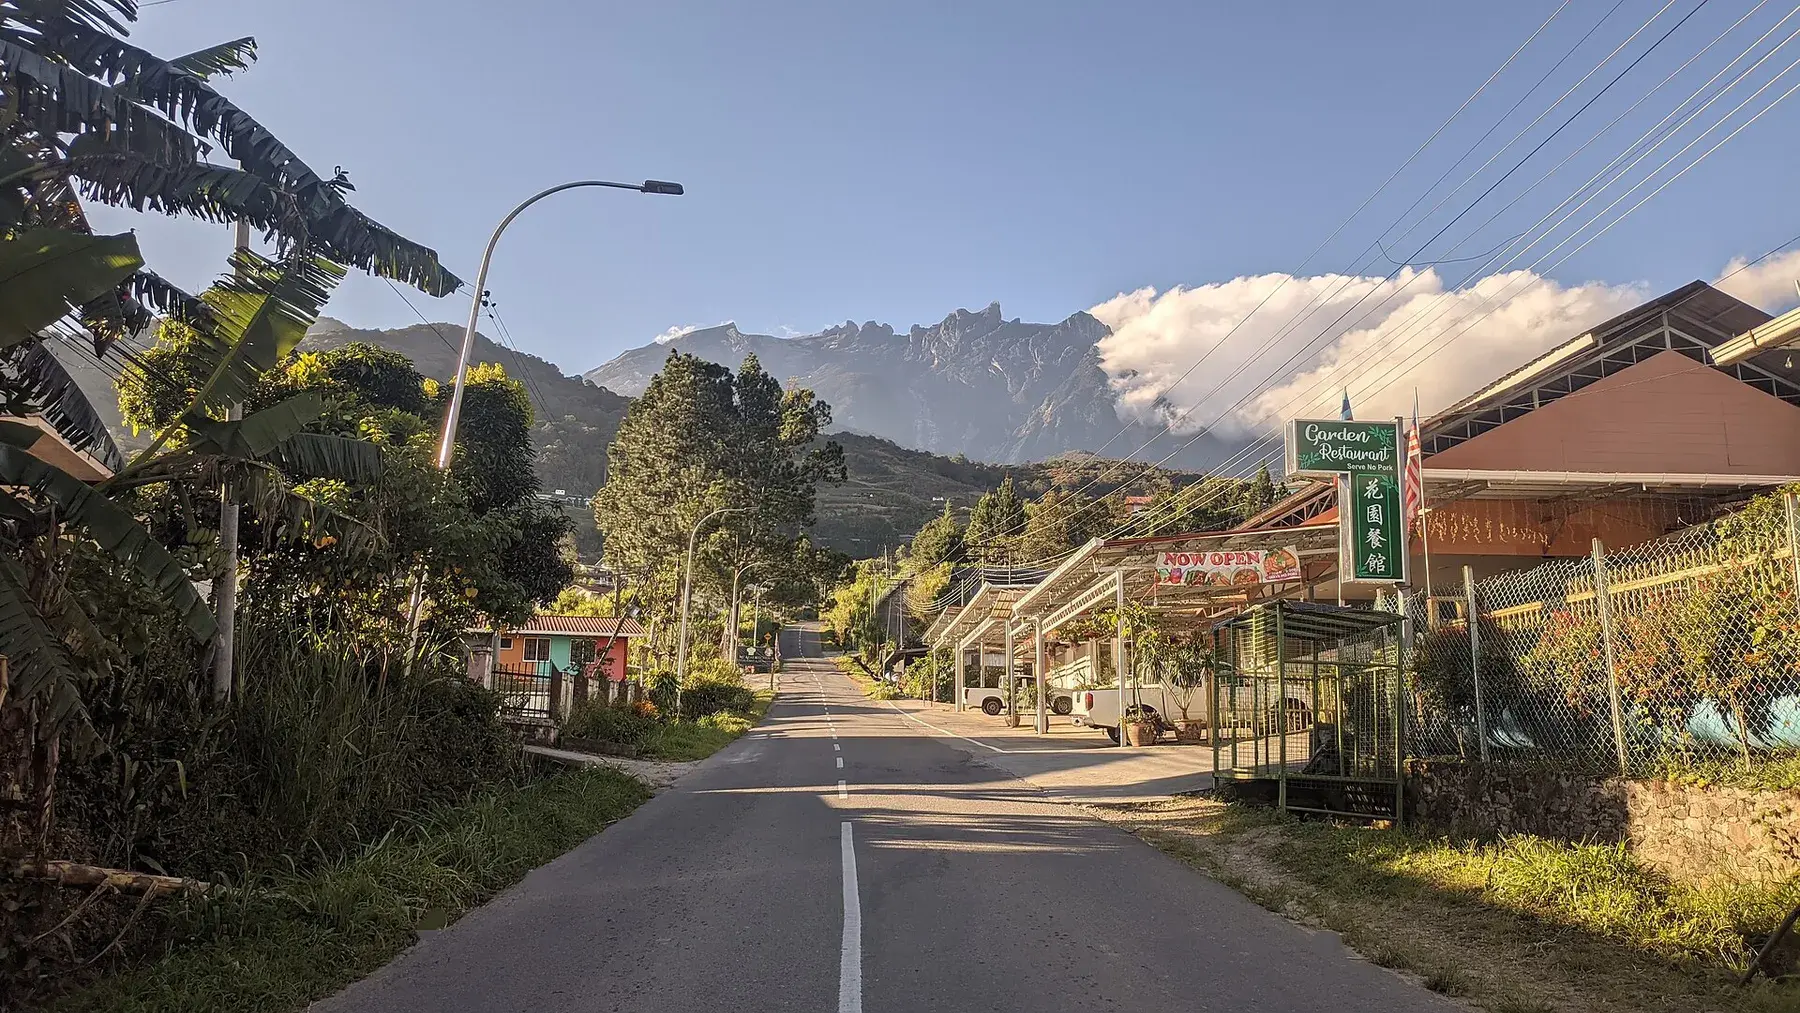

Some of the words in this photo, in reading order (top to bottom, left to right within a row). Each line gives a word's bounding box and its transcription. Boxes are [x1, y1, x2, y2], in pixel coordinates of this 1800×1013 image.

[1305, 424, 1370, 445] Garden
[1319, 443, 1390, 462] Restaurant
[1347, 462, 1366, 470] Serve
[1367, 463, 1376, 471] No
[1378, 463, 1393, 471] Pork
[1364, 478, 1387, 574] 花園餐館
[1164, 552, 1207, 566] NOW
[1210, 551, 1260, 566] OPEN
